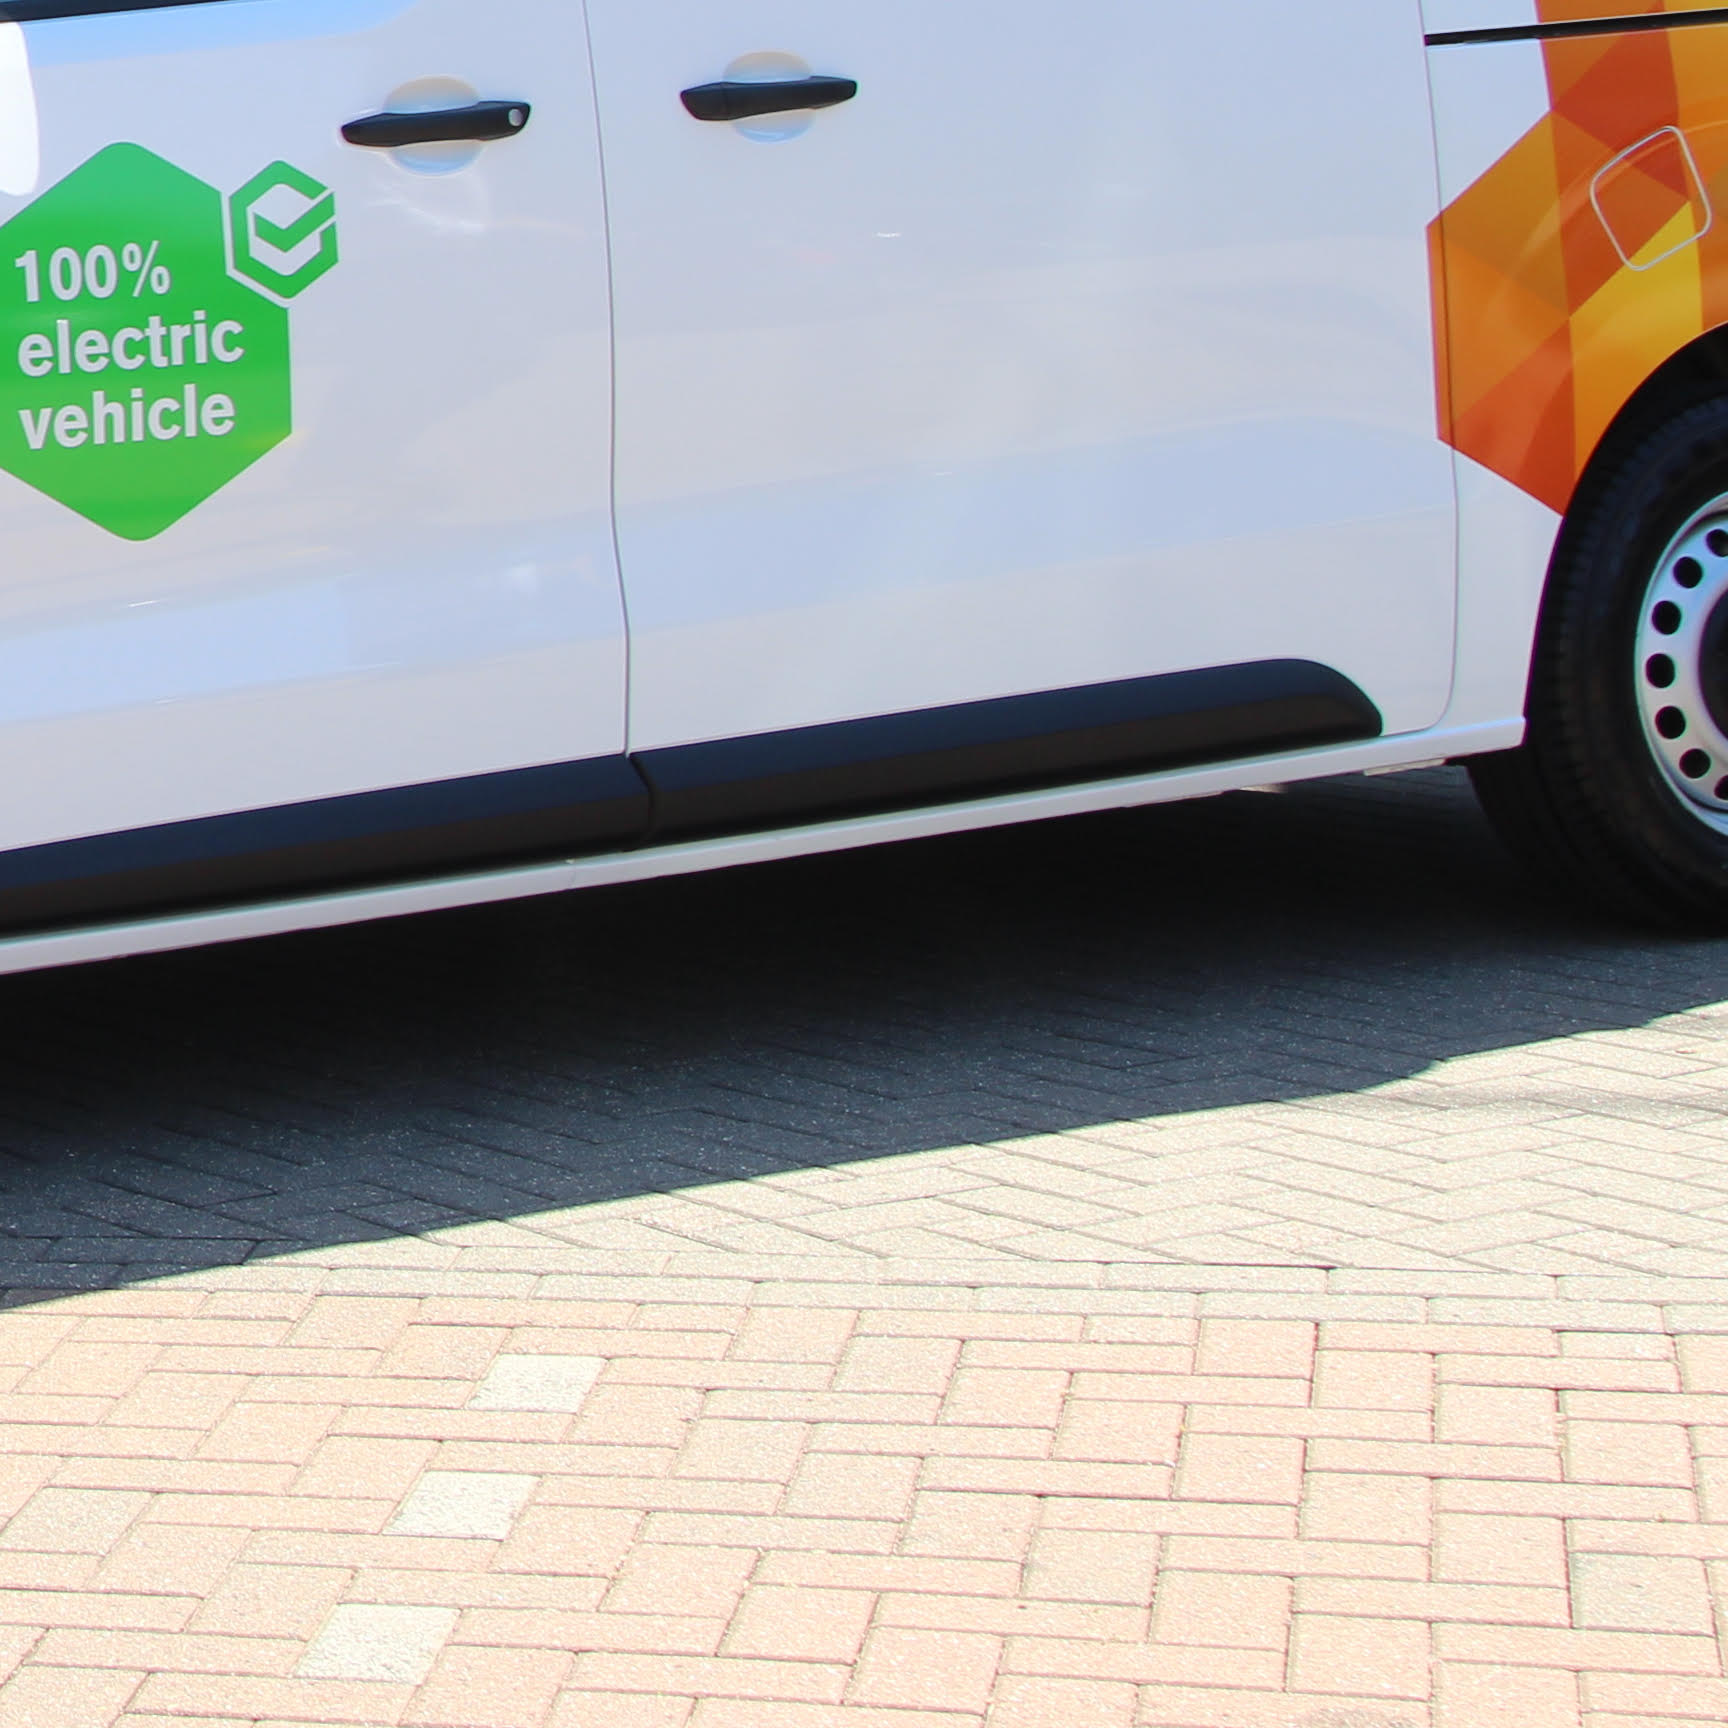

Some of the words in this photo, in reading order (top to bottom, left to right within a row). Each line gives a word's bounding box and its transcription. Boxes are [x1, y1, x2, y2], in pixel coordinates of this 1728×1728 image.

[15, 240, 171, 303] 100%
[17, 310, 244, 377] electric
[18, 383, 235, 450] vehicle
